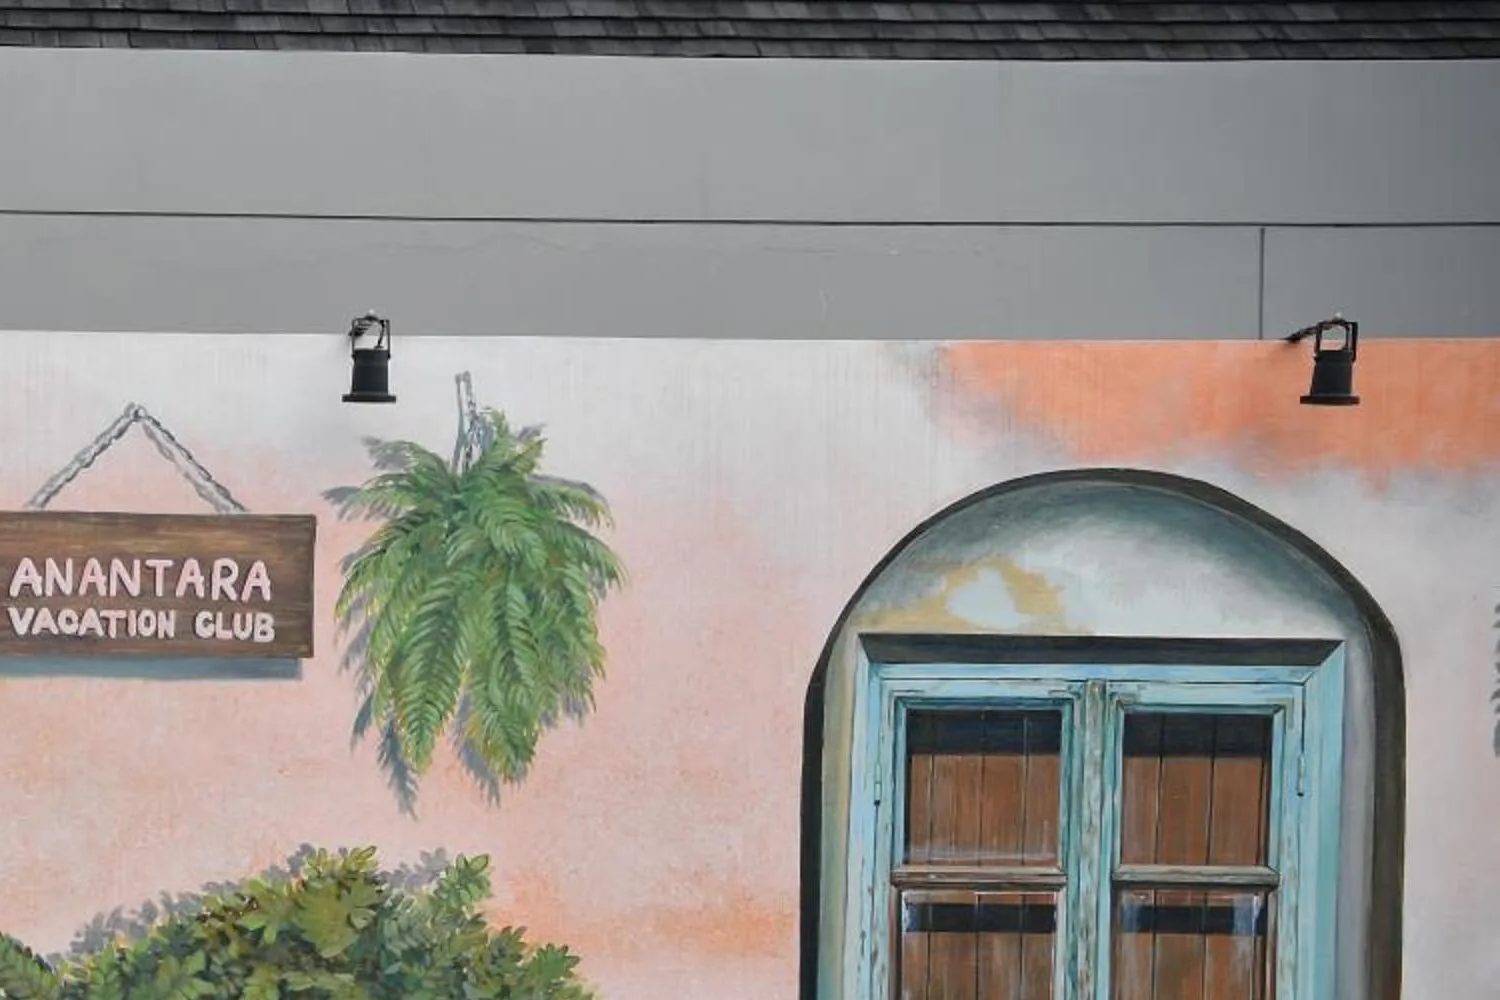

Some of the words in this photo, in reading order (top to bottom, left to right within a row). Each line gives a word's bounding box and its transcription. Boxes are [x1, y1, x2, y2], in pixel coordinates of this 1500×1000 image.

[8, 556, 272, 602] ANANTARA
[6, 606, 177, 639] VACATION
[194, 610, 276, 643] CLUB
